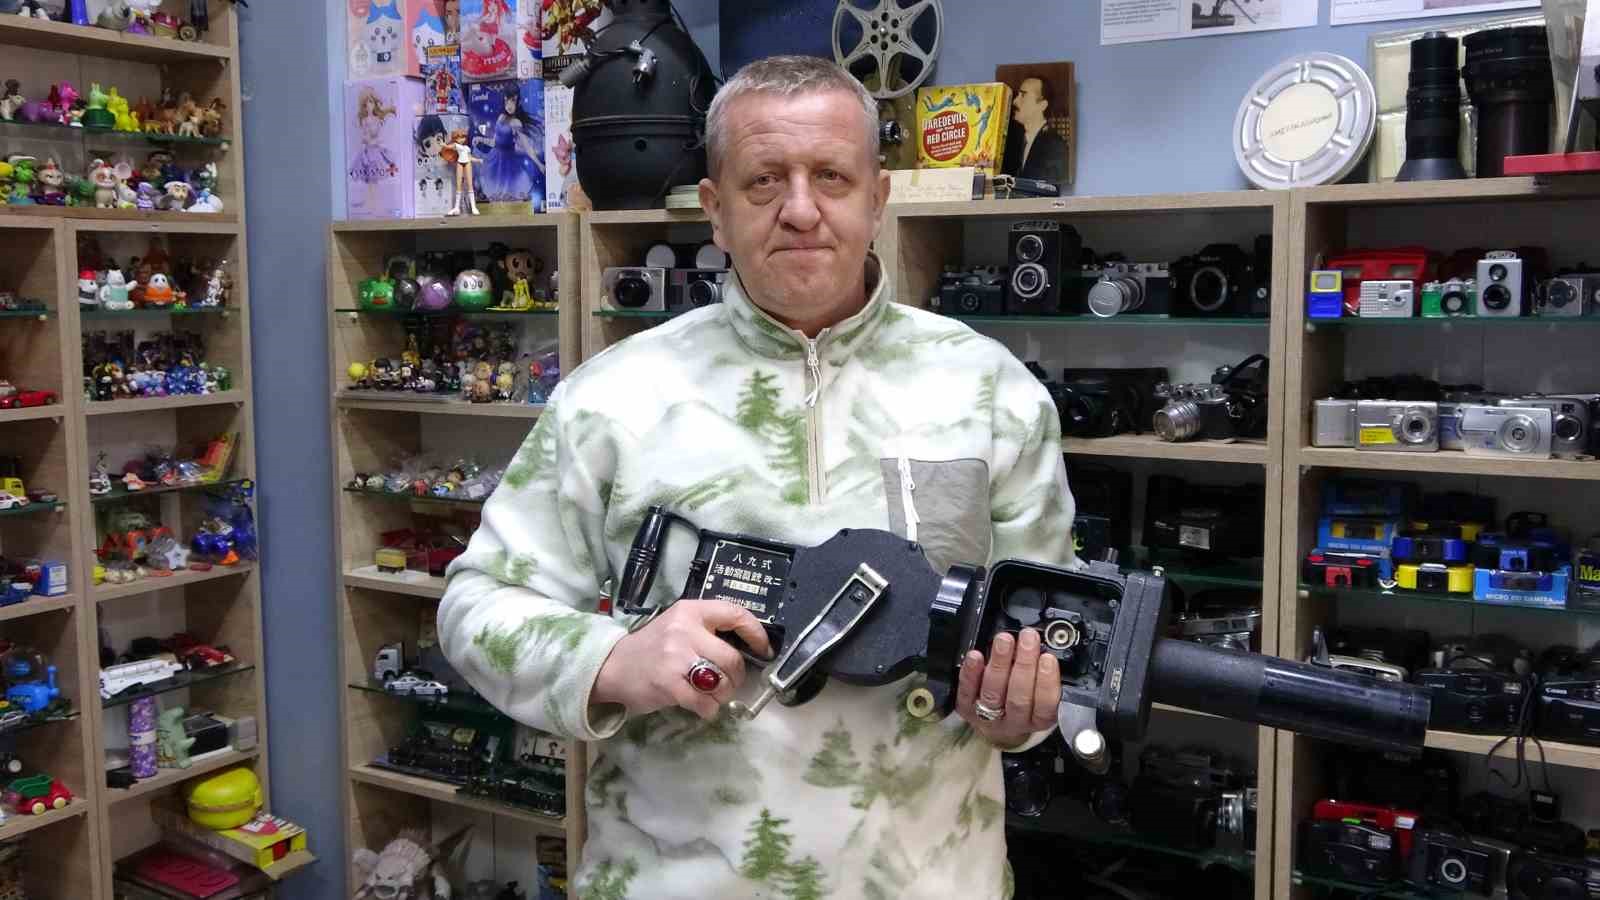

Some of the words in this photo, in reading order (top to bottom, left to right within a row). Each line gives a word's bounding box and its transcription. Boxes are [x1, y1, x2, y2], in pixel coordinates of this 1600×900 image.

[923, 112, 967, 128] DAREDEVILS
[927, 134, 941, 145] RED
[941, 128, 966, 141] CIRCLE
[732, 553, 772, 570] 八九式
[1485, 593, 1509, 601] MICRO
